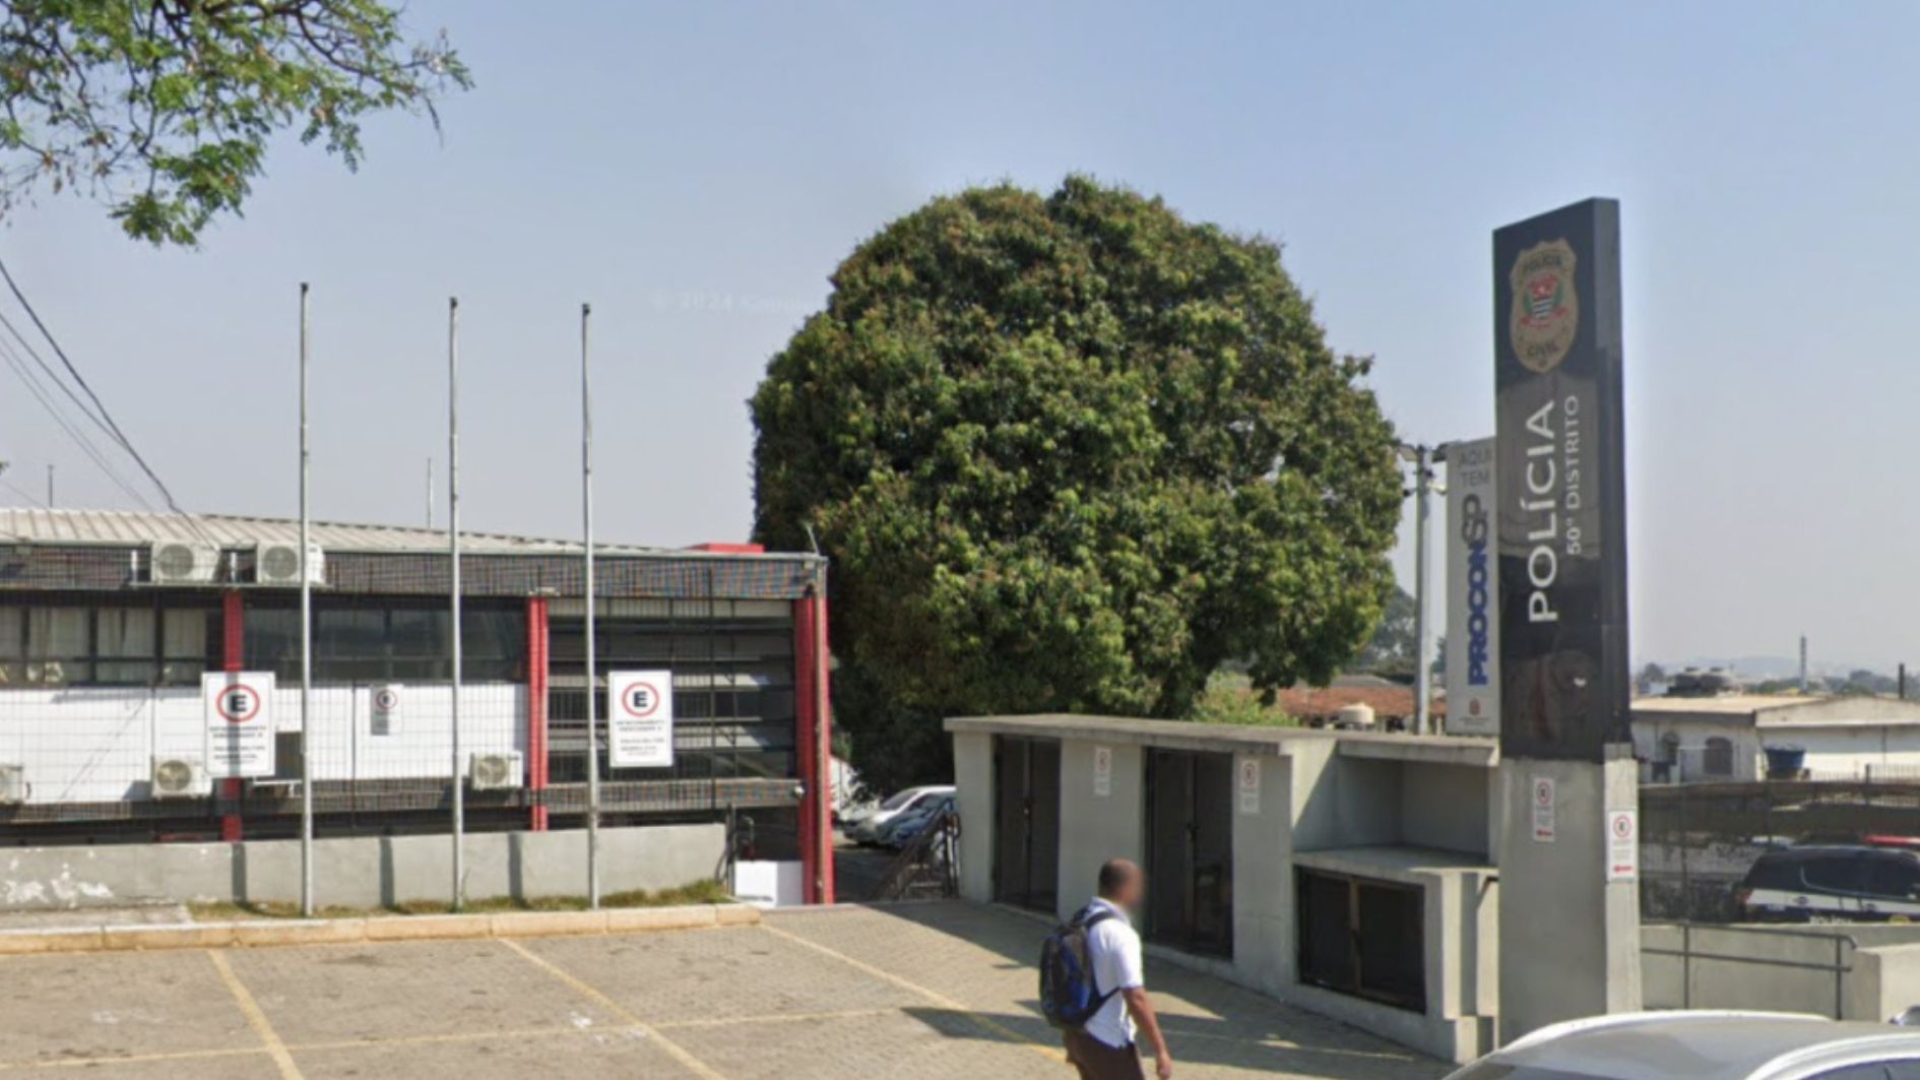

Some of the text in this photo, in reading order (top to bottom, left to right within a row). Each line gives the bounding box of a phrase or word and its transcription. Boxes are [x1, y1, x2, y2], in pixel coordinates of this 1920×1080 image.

[1564, 395, 1580, 510] DISTRITO
[1520, 399, 1559, 623] POLÍCIA
[229, 694, 247, 713] E
[633, 690, 648, 708] E
